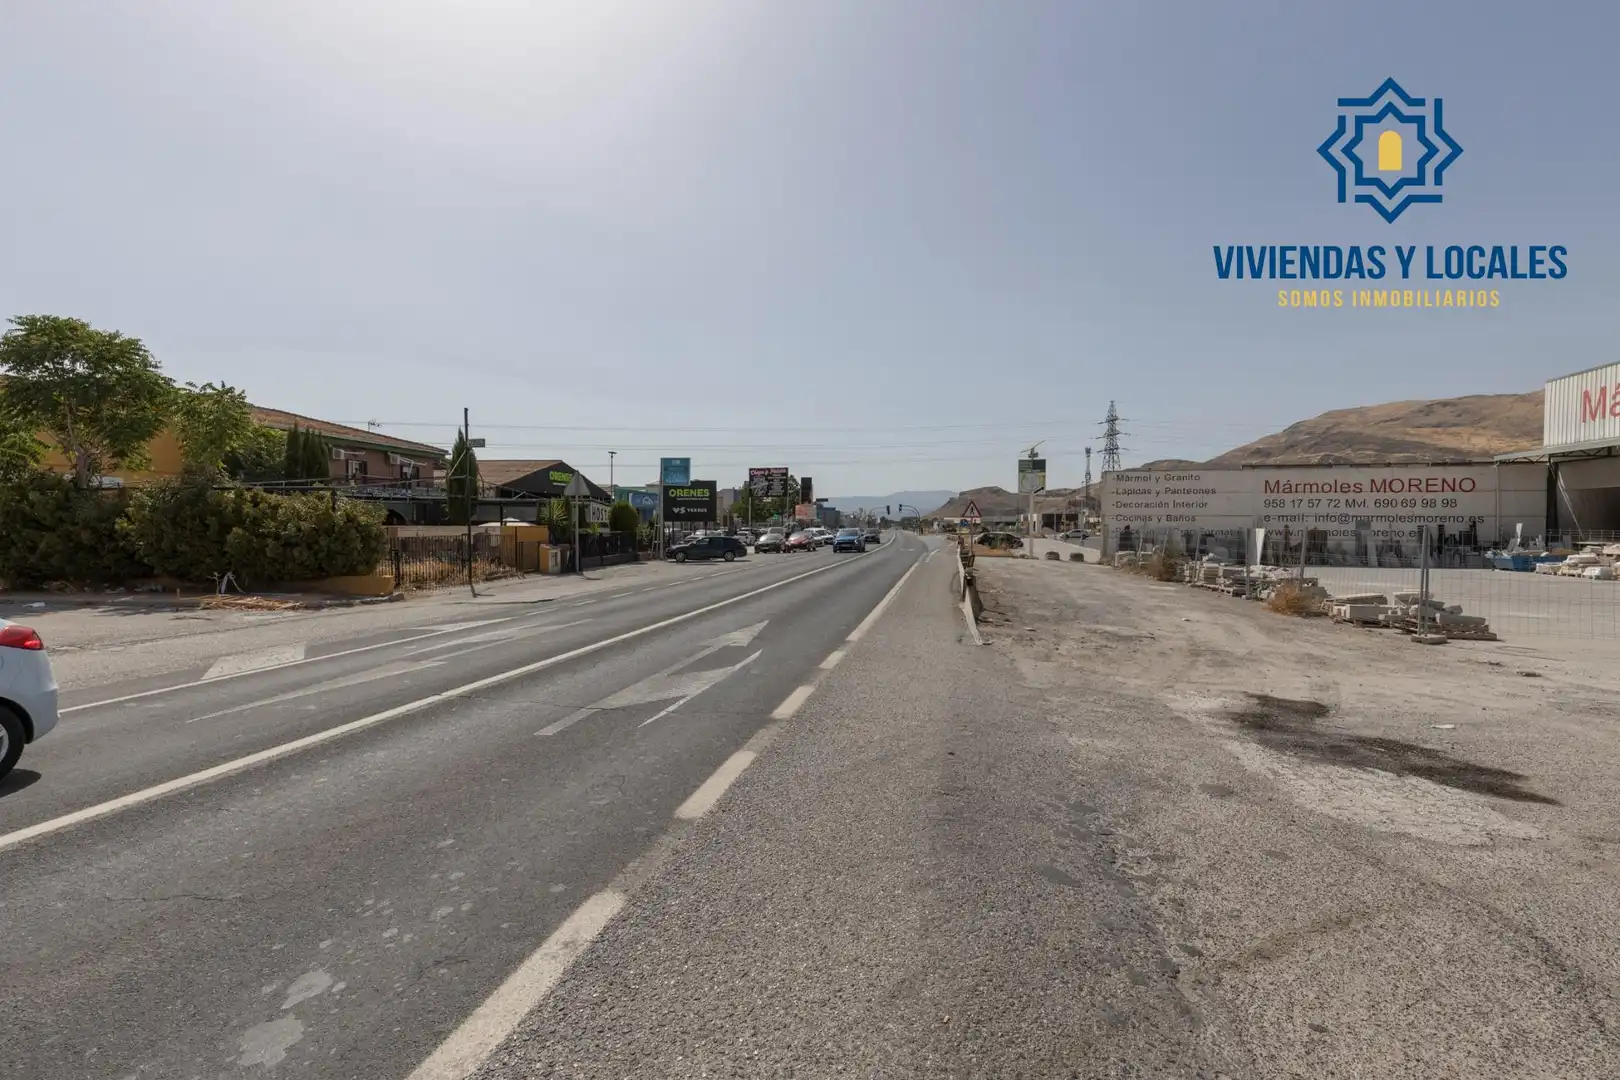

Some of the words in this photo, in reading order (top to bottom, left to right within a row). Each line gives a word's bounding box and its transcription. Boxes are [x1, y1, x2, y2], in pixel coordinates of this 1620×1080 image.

[1164, 473, 1201, 482] Granito
[1264, 479, 1363, 495] Mármoles
[1370, 477, 1476, 494] MORENO
[668, 488, 710, 498] ORENES
[1164, 487, 1217, 495] Panteones
[1173, 500, 1208, 509] Interior
[1263, 499, 1286, 509] 958
[1291, 499, 1303, 509] 17
[1307, 499, 1321, 509] 57
[1326, 499, 1341, 509] 72
[1374, 498, 1398, 508] 690
[1400, 498, 1417, 508] 69
[1421, 498, 1437, 508] 98
[1441, 498, 1458, 508] 98
